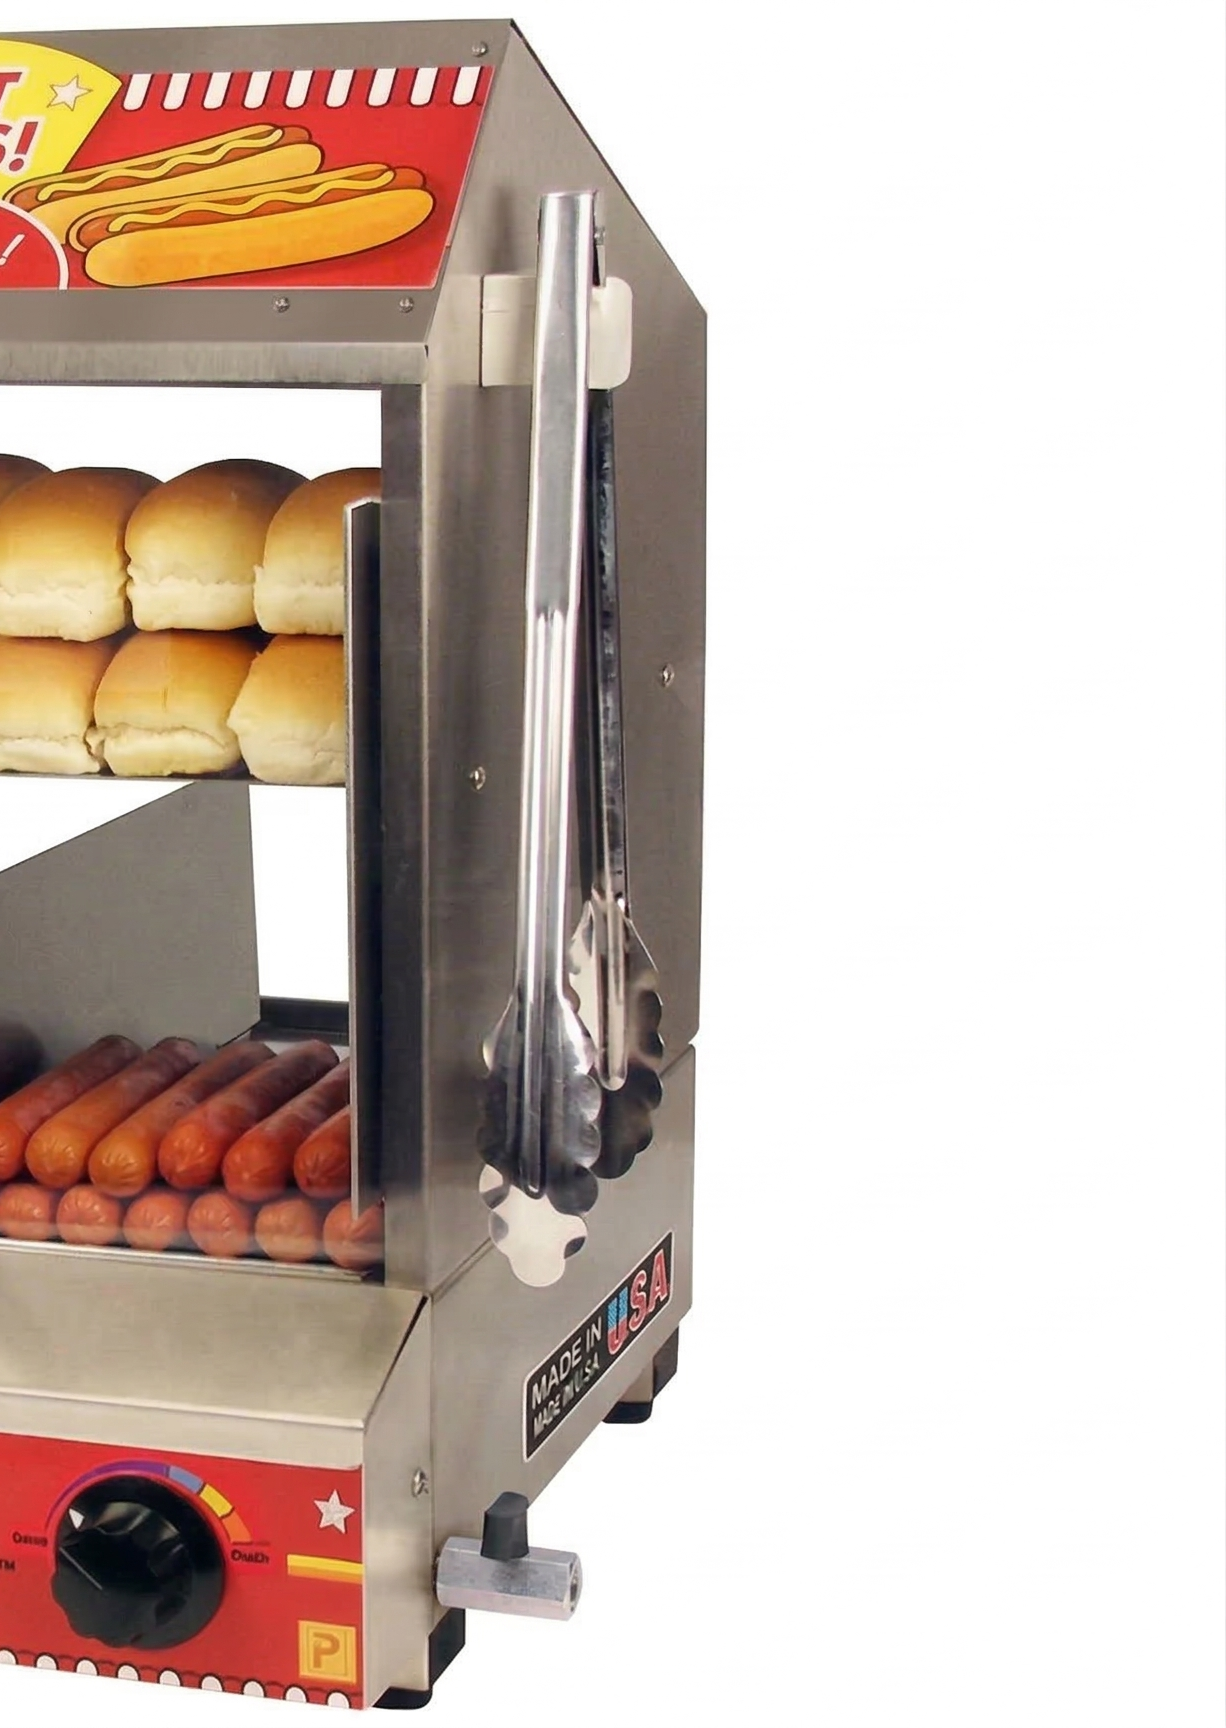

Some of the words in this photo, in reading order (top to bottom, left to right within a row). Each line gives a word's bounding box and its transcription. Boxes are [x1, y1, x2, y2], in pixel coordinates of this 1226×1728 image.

[531, 1340, 583, 1411] MADE
[585, 1315, 603, 1353] IN
[606, 1247, 669, 1356] USA
